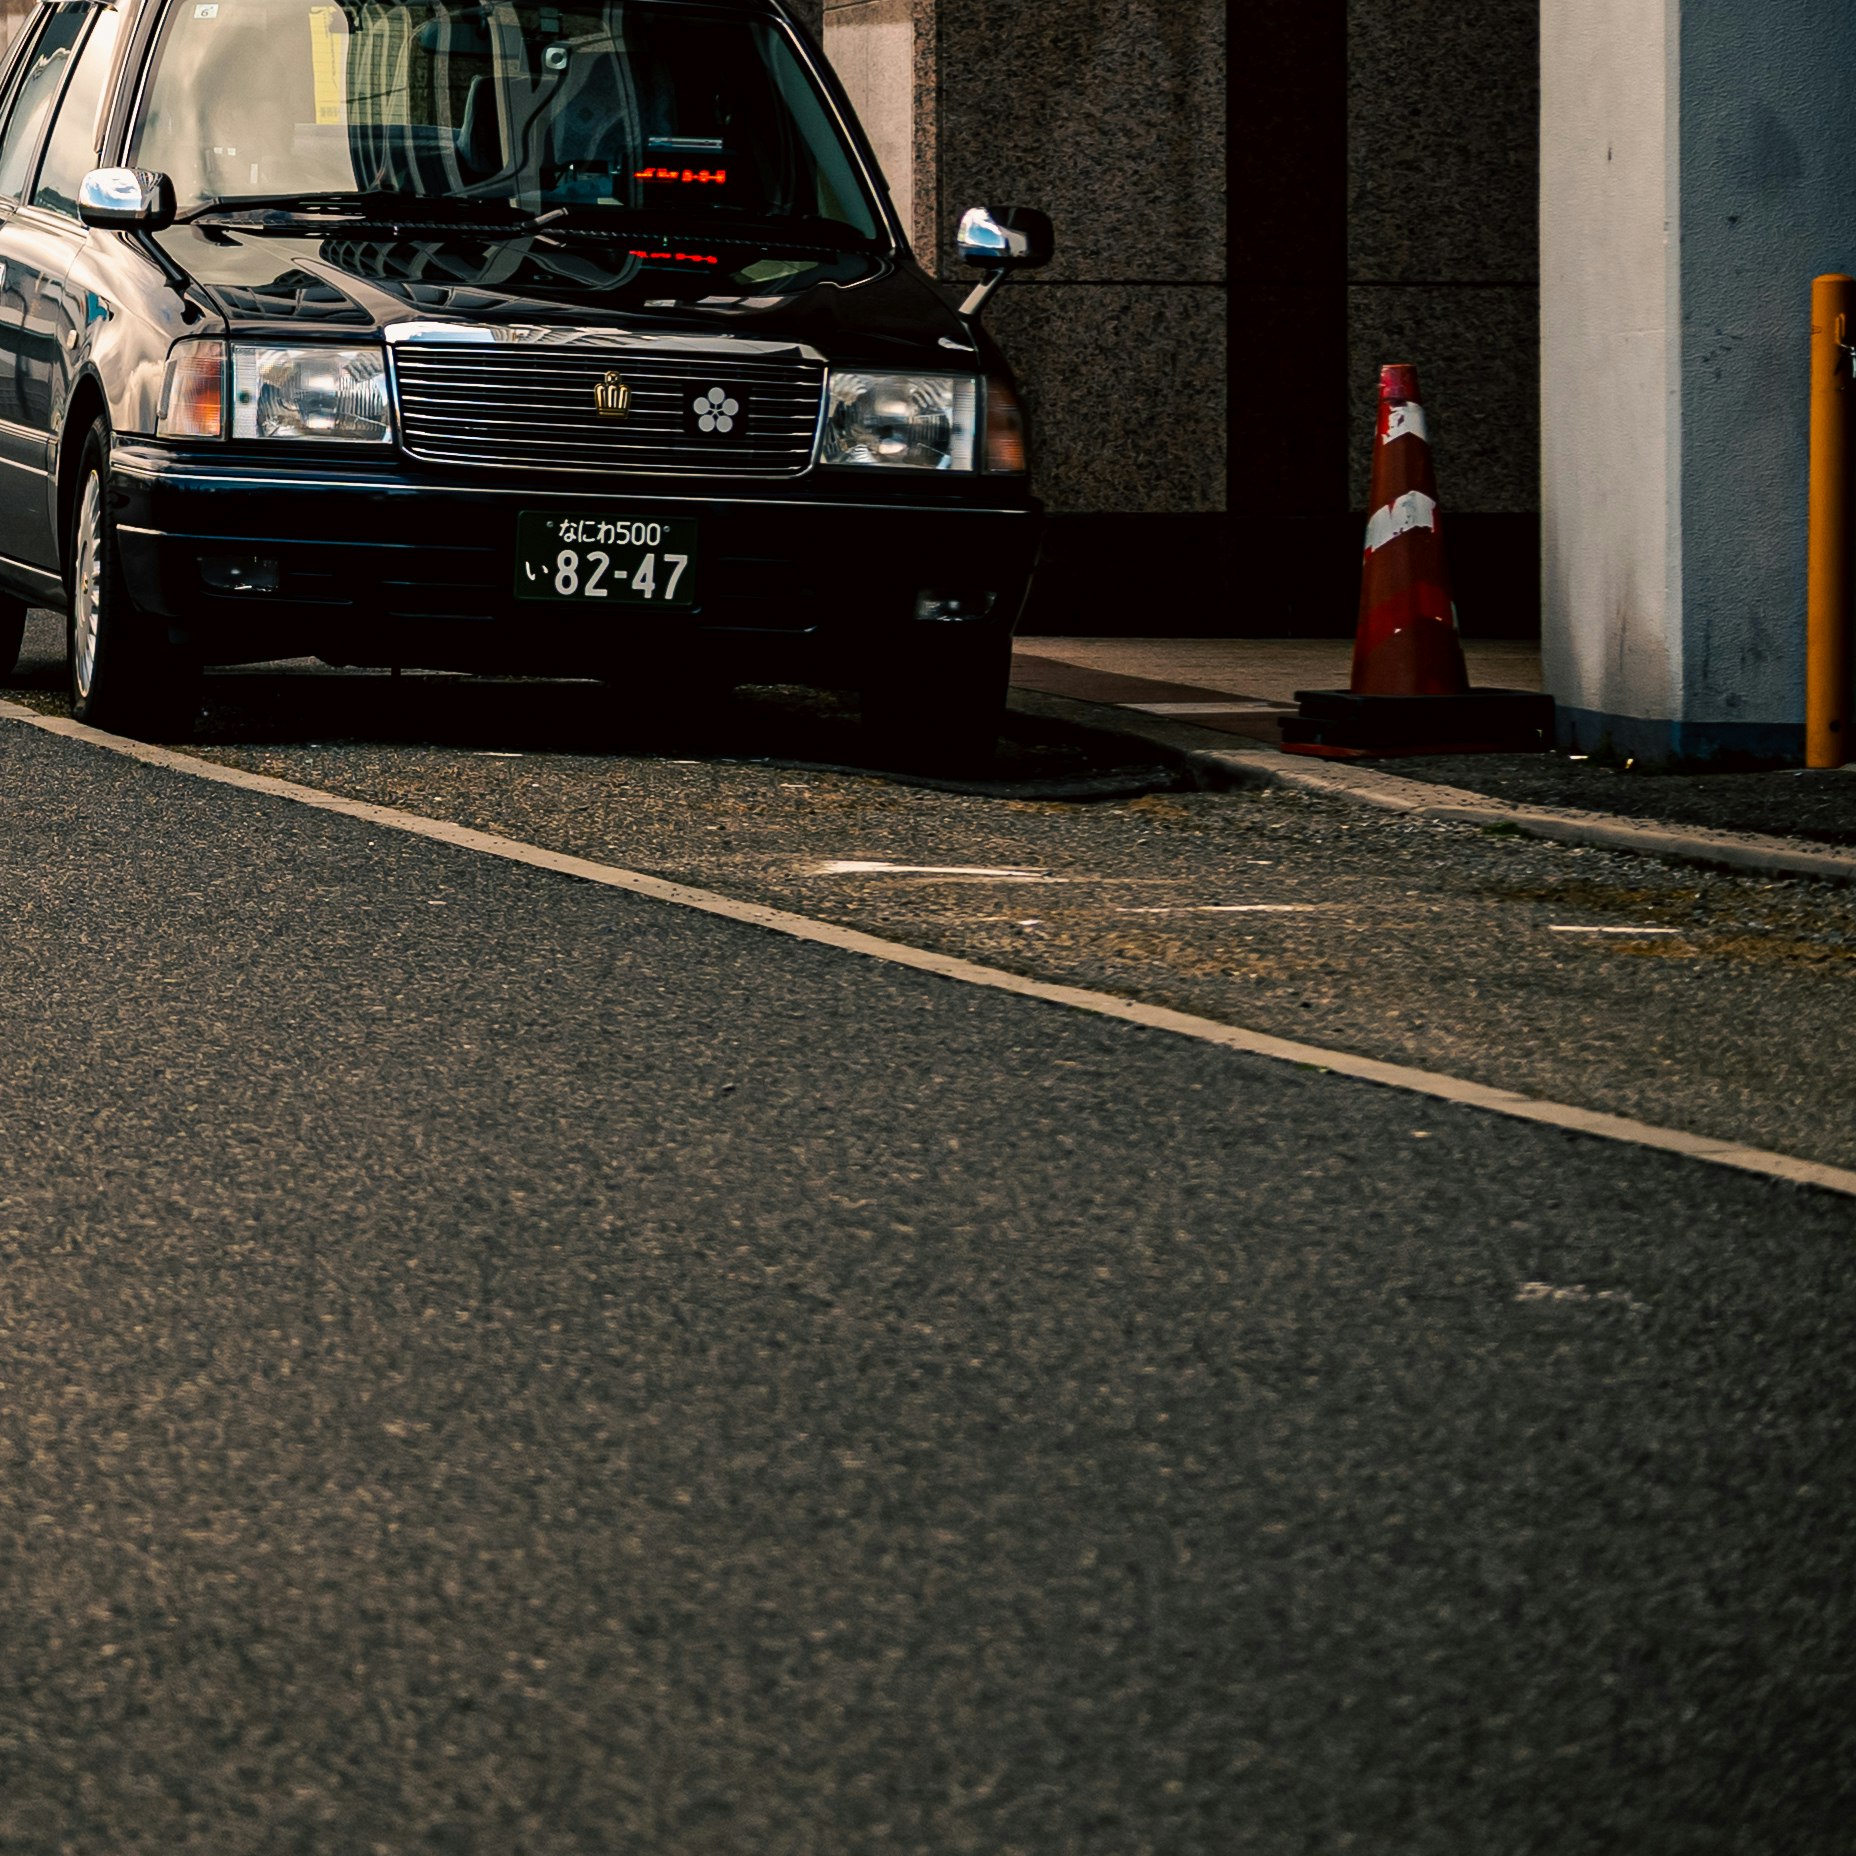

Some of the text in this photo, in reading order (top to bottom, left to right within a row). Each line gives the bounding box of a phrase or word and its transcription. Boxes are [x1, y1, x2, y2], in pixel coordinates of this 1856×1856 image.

[558, 518, 661, 547] なにわ500
[524, 548, 689, 601] い 82-47
